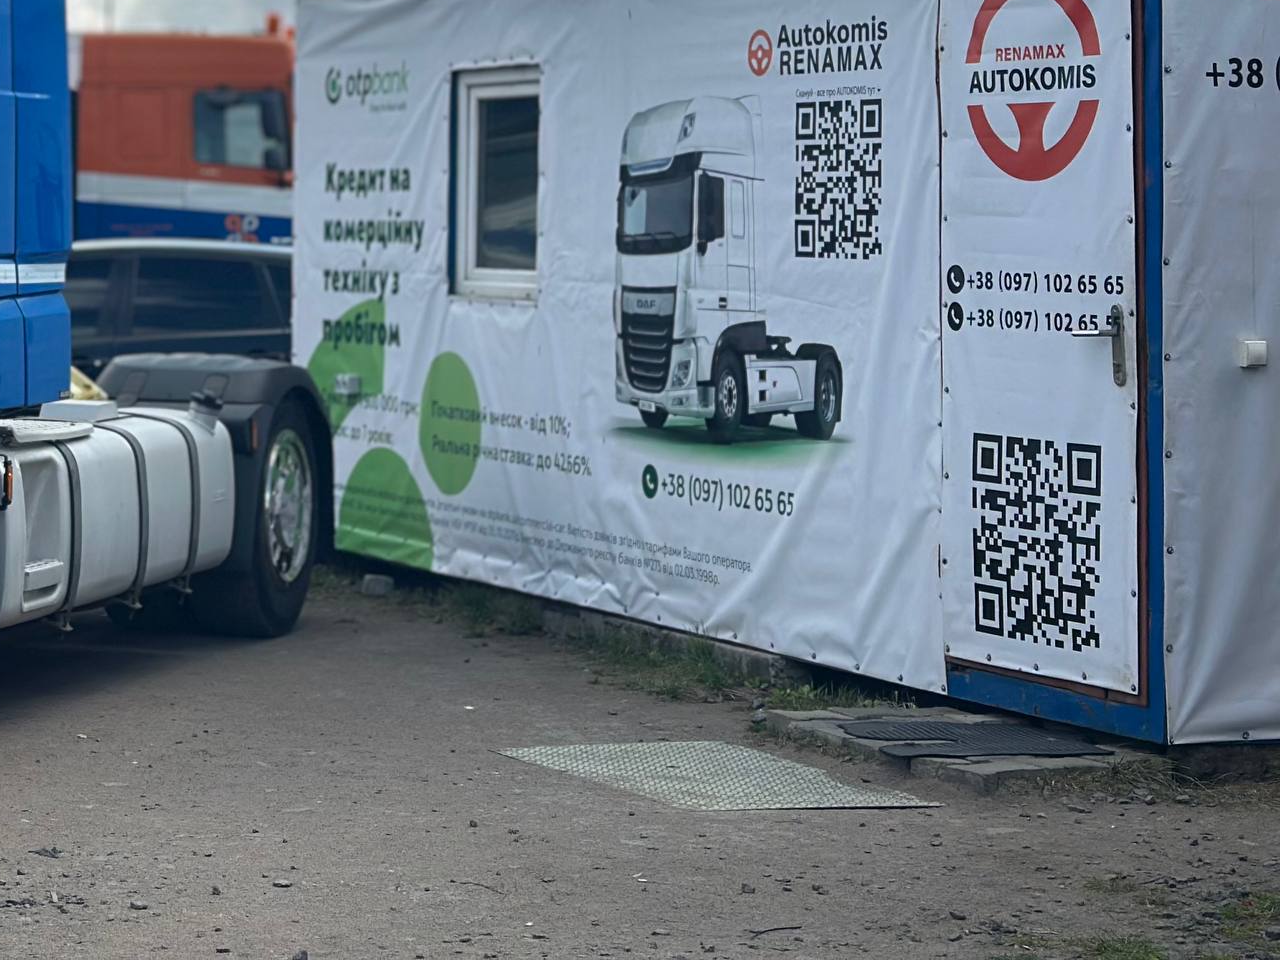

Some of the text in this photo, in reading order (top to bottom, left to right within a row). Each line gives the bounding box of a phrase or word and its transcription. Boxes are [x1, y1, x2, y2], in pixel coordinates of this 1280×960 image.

[777, 15, 888, 48] Autokomis
[780, 43, 882, 76] RENAMAX
[995, 44, 1066, 62] RENAMAX
[969, 64, 1097, 94] AUTOKOMIS
[1206, 57, 1264, 88] +38
[325, 162, 410, 201] Кредит на
[324, 208, 425, 253] комерційну
[324, 258, 399, 302] техніку з
[967, 270, 1124, 295] +38 (097) 102 65 65
[323, 310, 400, 350] пробігом
[967, 308, 994, 328] +38
[999, 308, 1039, 332] (097)
[1044, 312, 1073, 332] 102
[1078, 314, 1099, 331] 65
[536, 453, 551, 473] до
[662, 473, 795, 516] +38 (097) 102 65 65
